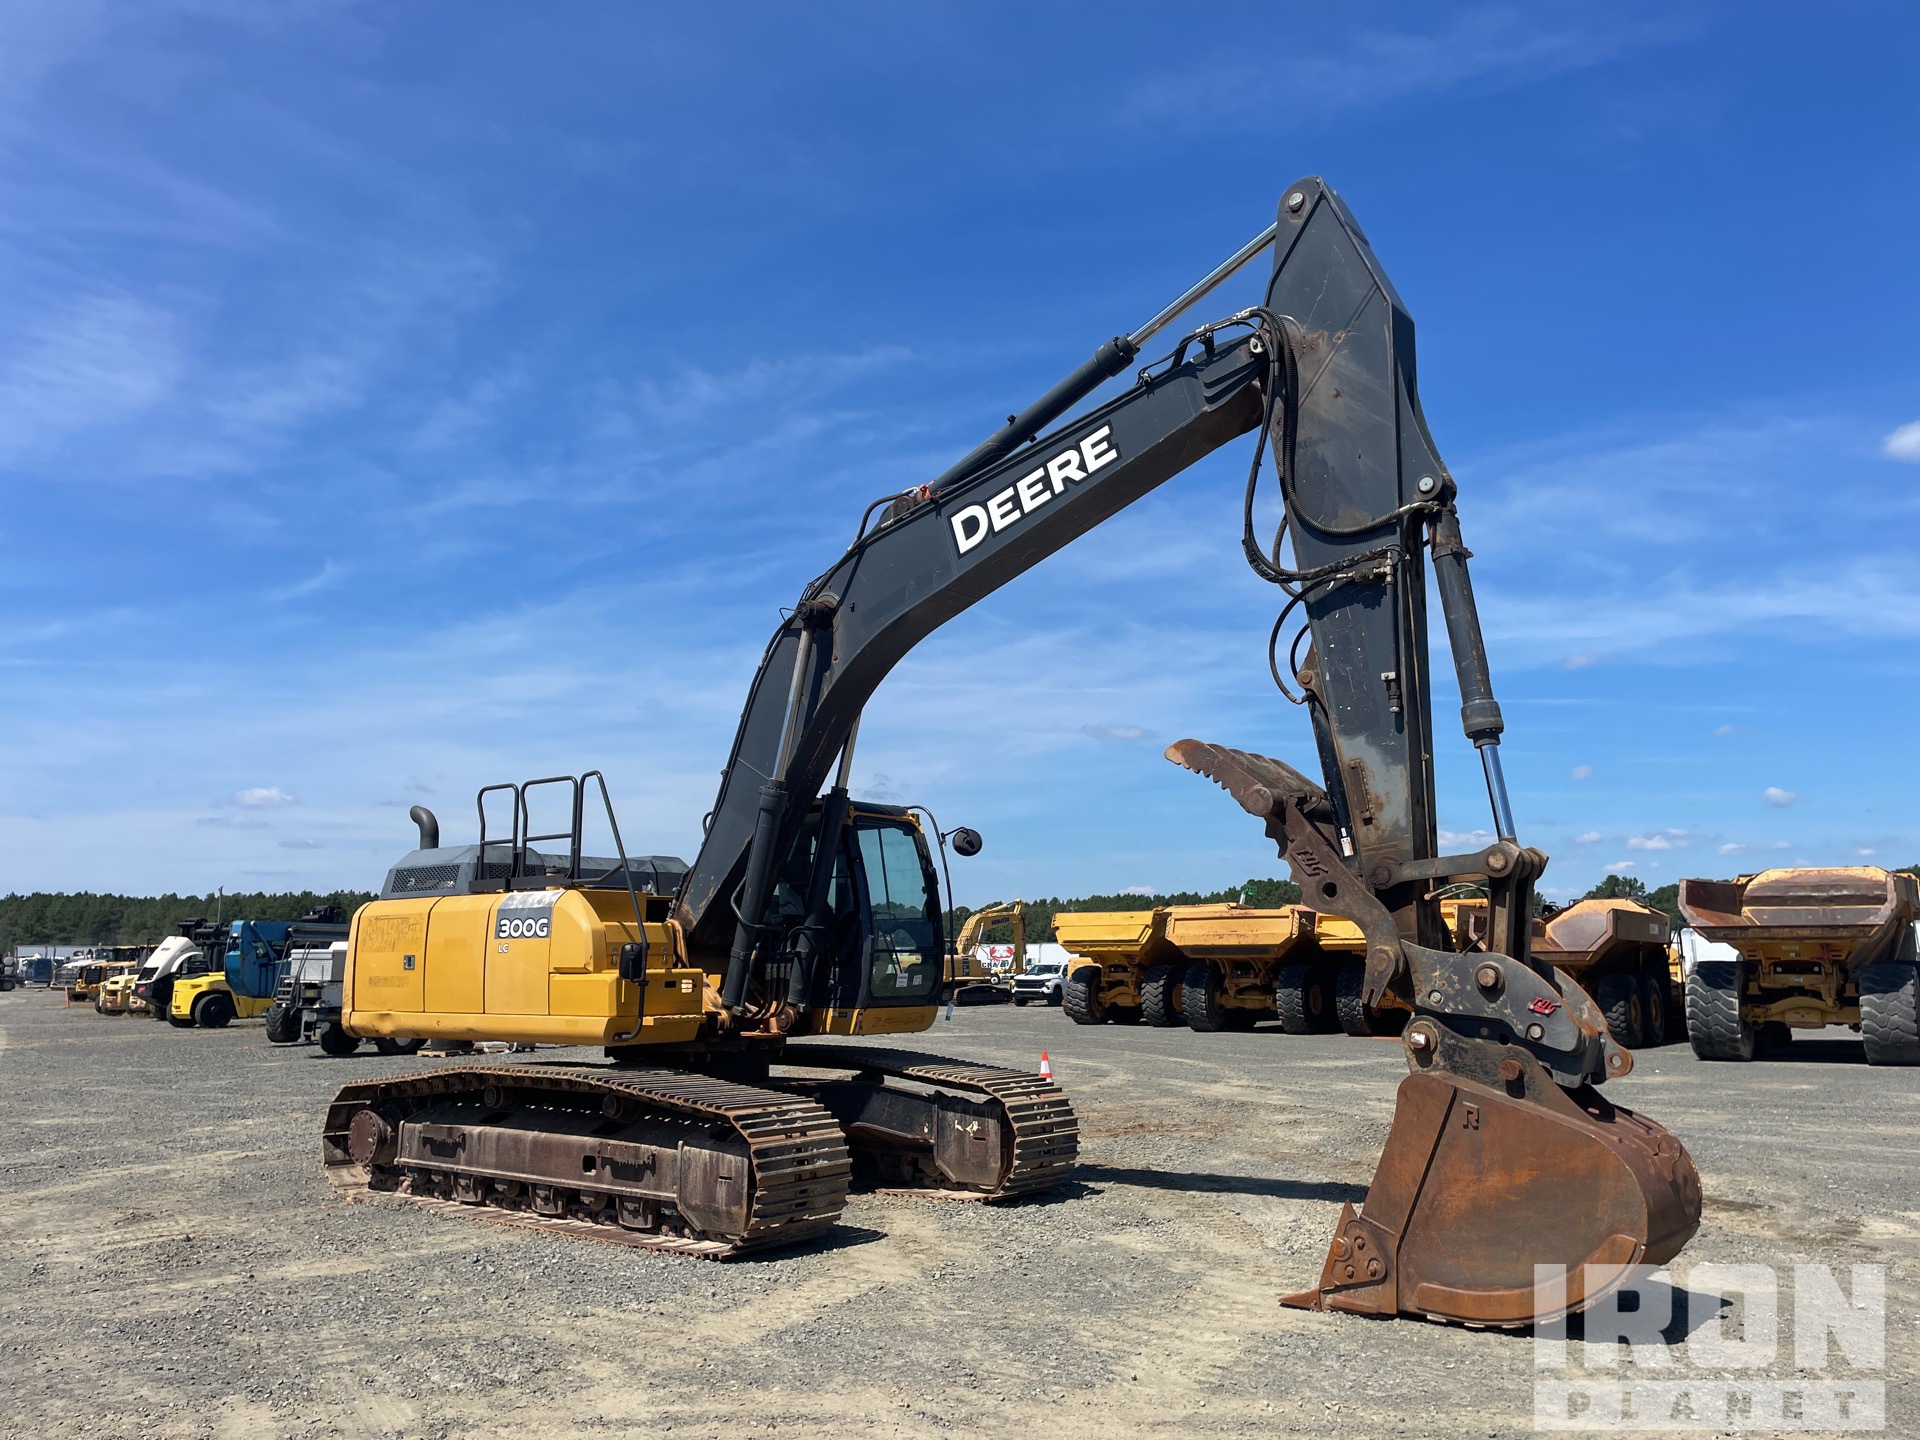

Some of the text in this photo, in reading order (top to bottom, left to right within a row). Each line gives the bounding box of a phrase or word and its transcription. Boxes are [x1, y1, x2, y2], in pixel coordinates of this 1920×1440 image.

[951, 425, 1118, 554] DEERE
[498, 917, 549, 938] 300G
[498, 943, 509, 953] LC
